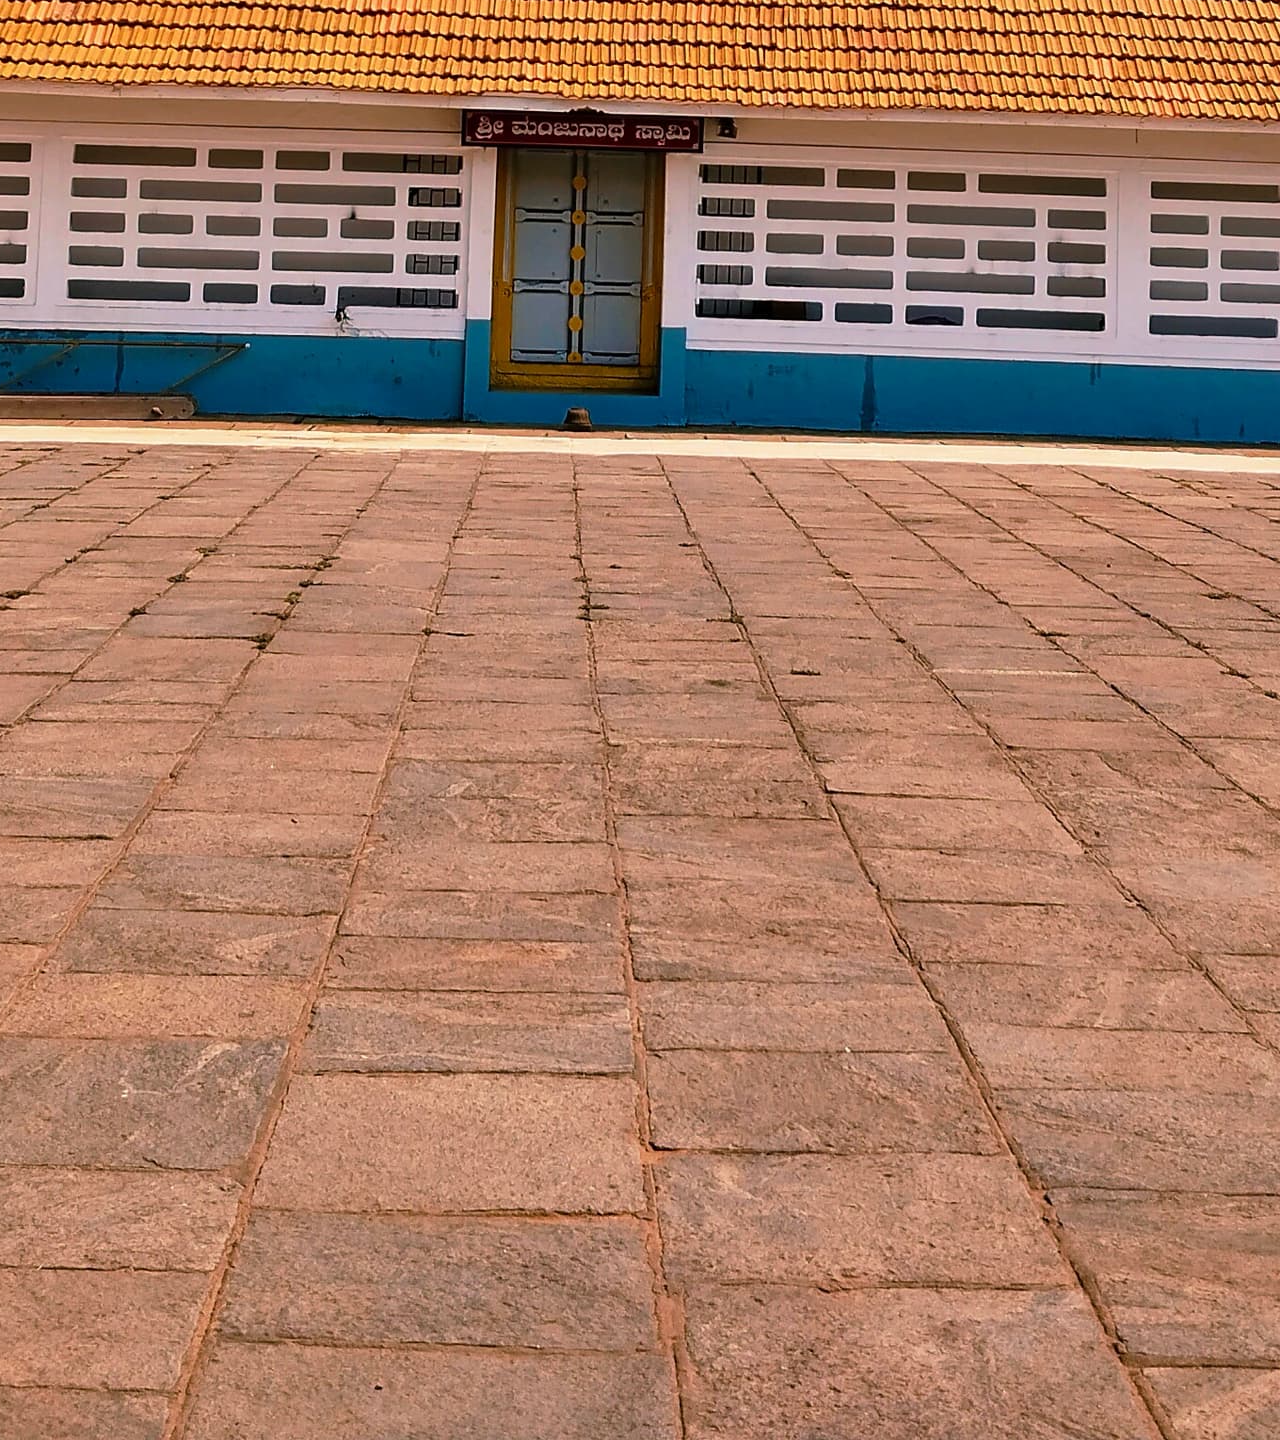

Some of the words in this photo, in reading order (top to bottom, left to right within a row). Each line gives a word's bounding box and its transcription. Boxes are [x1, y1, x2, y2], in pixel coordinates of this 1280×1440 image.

[475, 115, 504, 140] ಶ್ರೀ
[511, 116, 625, 142] ಮಂಜುನಾಥ
[635, 122, 691, 146] ಸ್ವಾಮಿ
